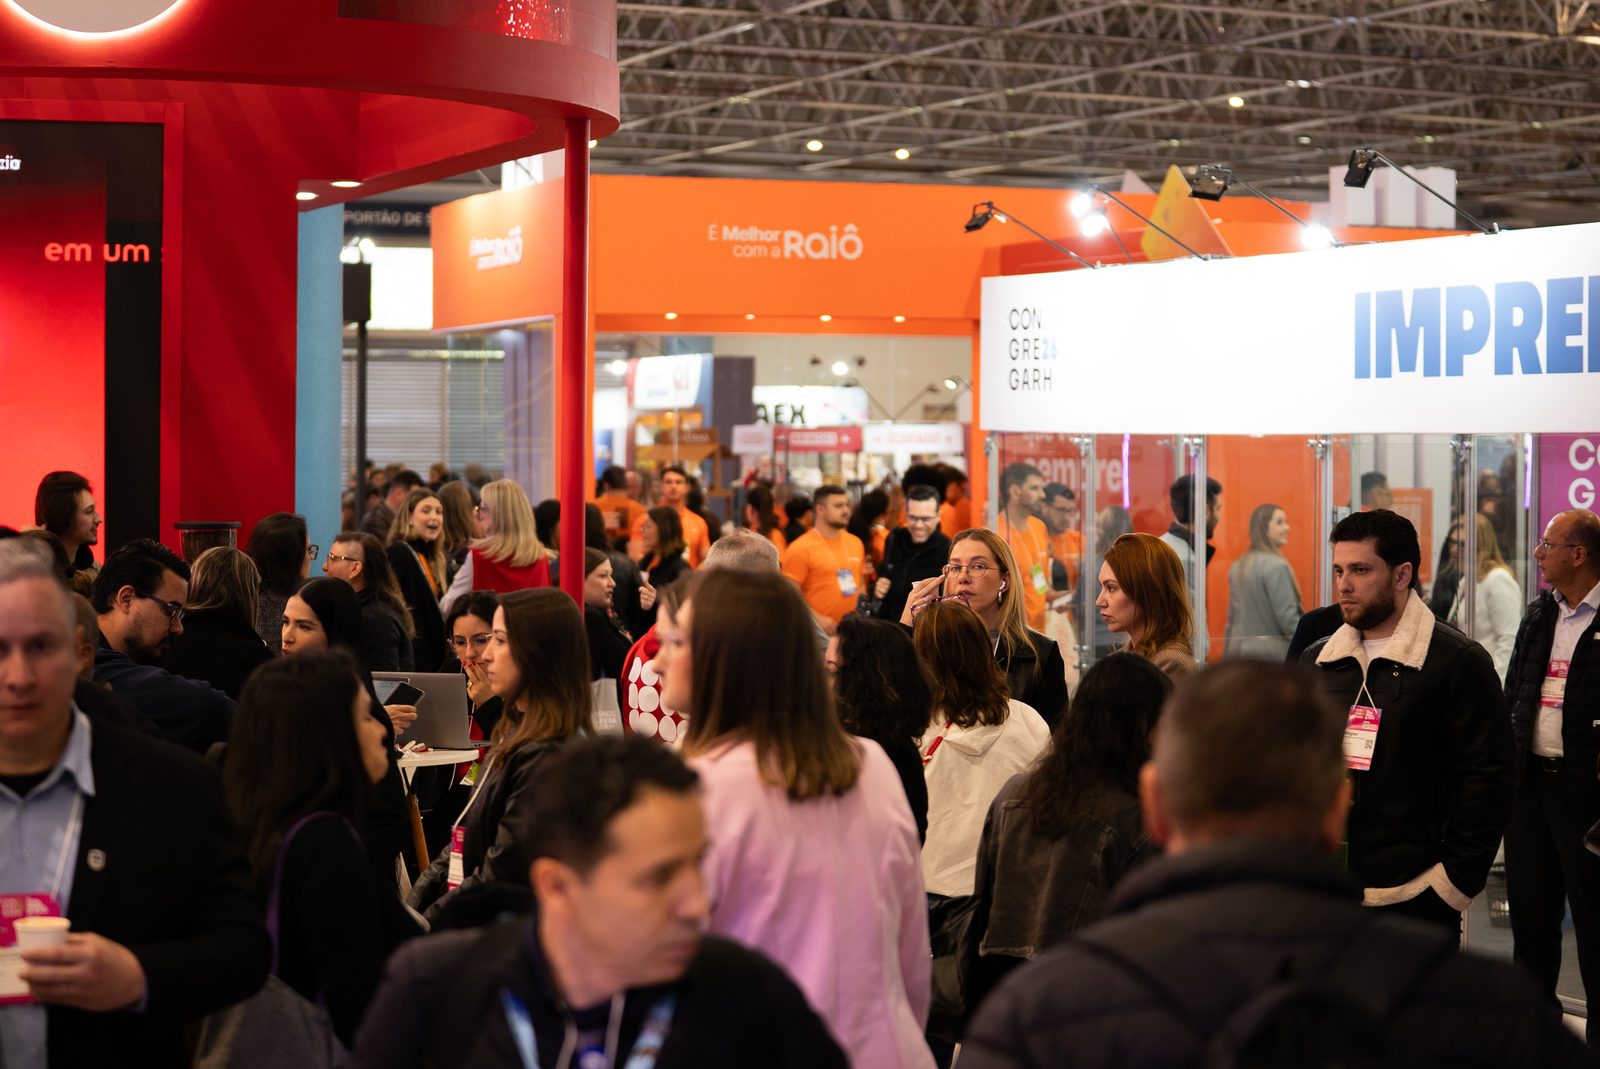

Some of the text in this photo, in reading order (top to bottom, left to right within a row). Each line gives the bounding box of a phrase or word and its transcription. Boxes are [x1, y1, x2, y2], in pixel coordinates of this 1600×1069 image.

[344, 209, 401, 225] PORTÃO
[403, 211, 423, 226] DE
[722, 225, 782, 242] Melhor
[783, 223, 864, 260] Raiô
[44, 242, 92, 262] em
[103, 243, 150, 263] um
[732, 245, 781, 258] com a
[1354, 275, 1600, 380] IMPRE
[1008, 367, 1052, 391] GARH
